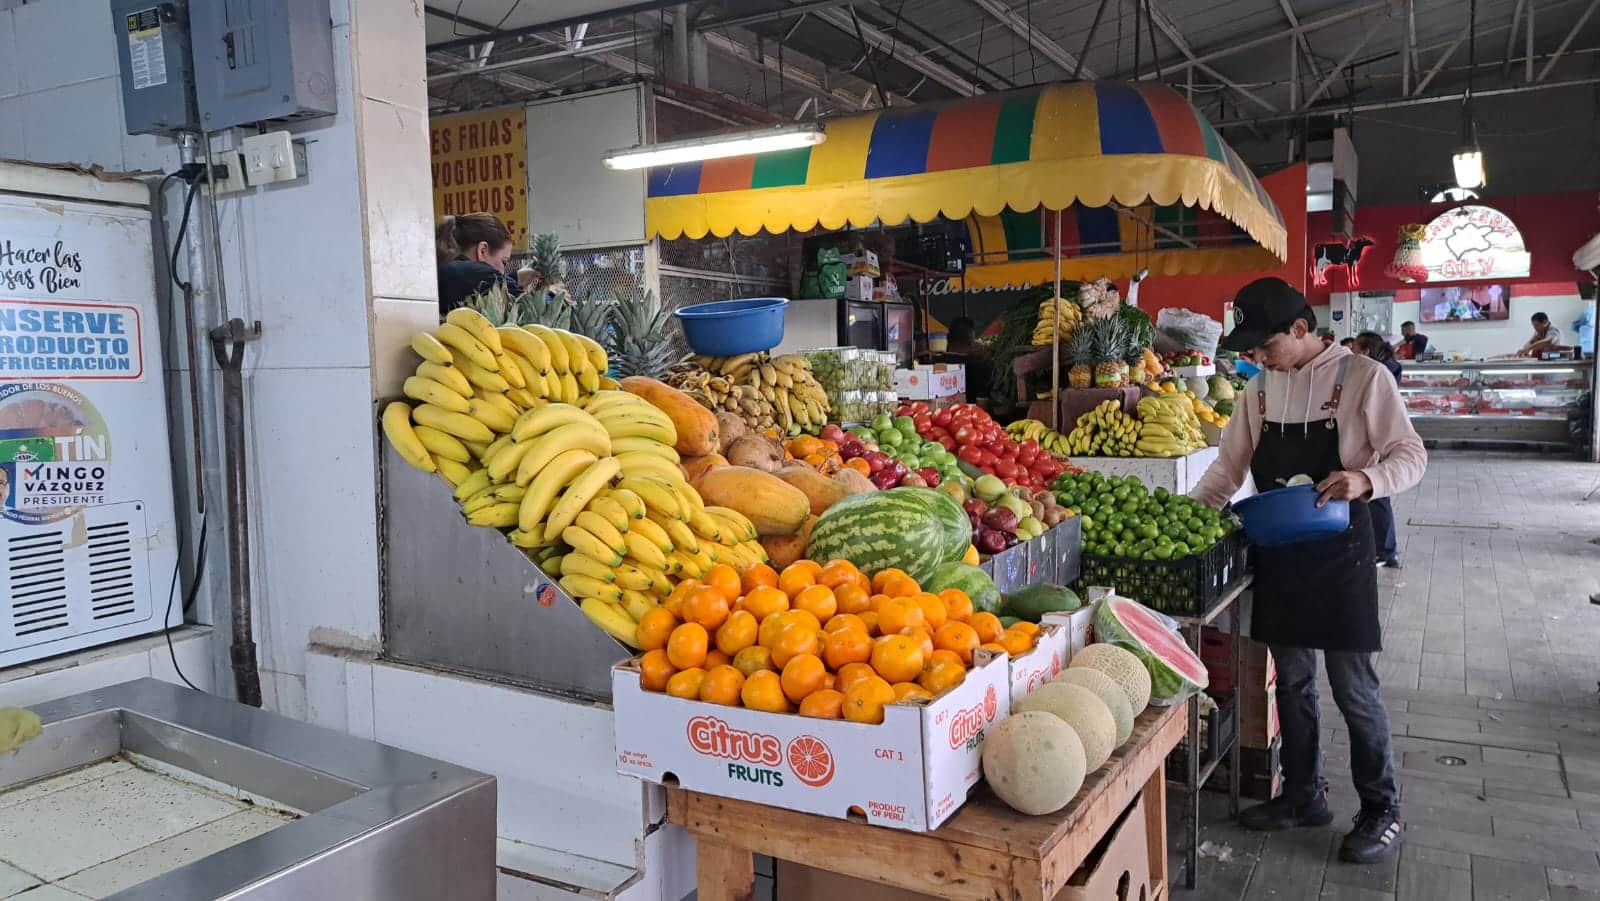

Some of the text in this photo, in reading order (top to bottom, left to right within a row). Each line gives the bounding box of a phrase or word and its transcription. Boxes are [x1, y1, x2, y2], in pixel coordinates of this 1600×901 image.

[458, 117, 512, 151] FRIAS
[431, 152, 513, 188] YOGHURT
[443, 185, 515, 215] HUEVOS
[0, 239, 82, 273] Hacer las
[1441, 257, 1495, 278] OLY
[40, 266, 80, 294] Bien
[0, 308, 124, 334] NSERVE
[0, 335, 128, 355] RODUCTO
[0, 354, 130, 370] FRIGERACIÓN
[23, 463, 105, 481] MINGO
[24, 480, 105, 493] VÁZQUEZ
[23, 495, 105, 505] PRESIDENTE
[949, 702, 984, 750] Citrus
[688, 717, 781, 764] Citrus
[966, 727, 984, 754] FRUITS
[874, 748, 903, 761] CAT 1
[728, 763, 784, 787] FRUITS
[868, 801, 905, 814] PRODUCT
[883, 811, 904, 822] PERU
